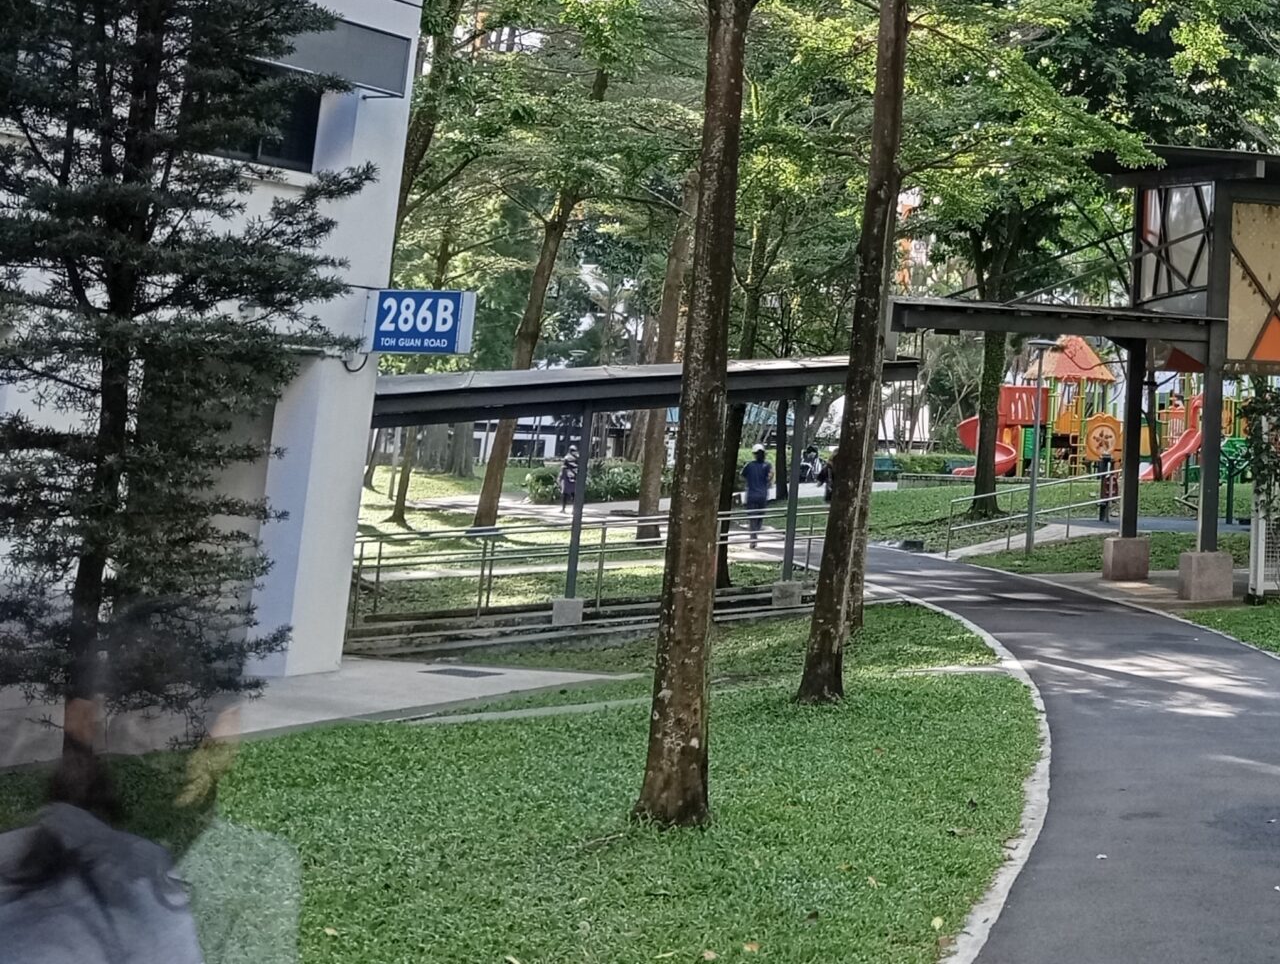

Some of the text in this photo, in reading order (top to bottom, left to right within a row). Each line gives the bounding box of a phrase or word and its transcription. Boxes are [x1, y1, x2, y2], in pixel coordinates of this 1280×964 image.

[379, 297, 454, 332] 286B
[380, 337, 448, 348] TOH GUAN ROAD
